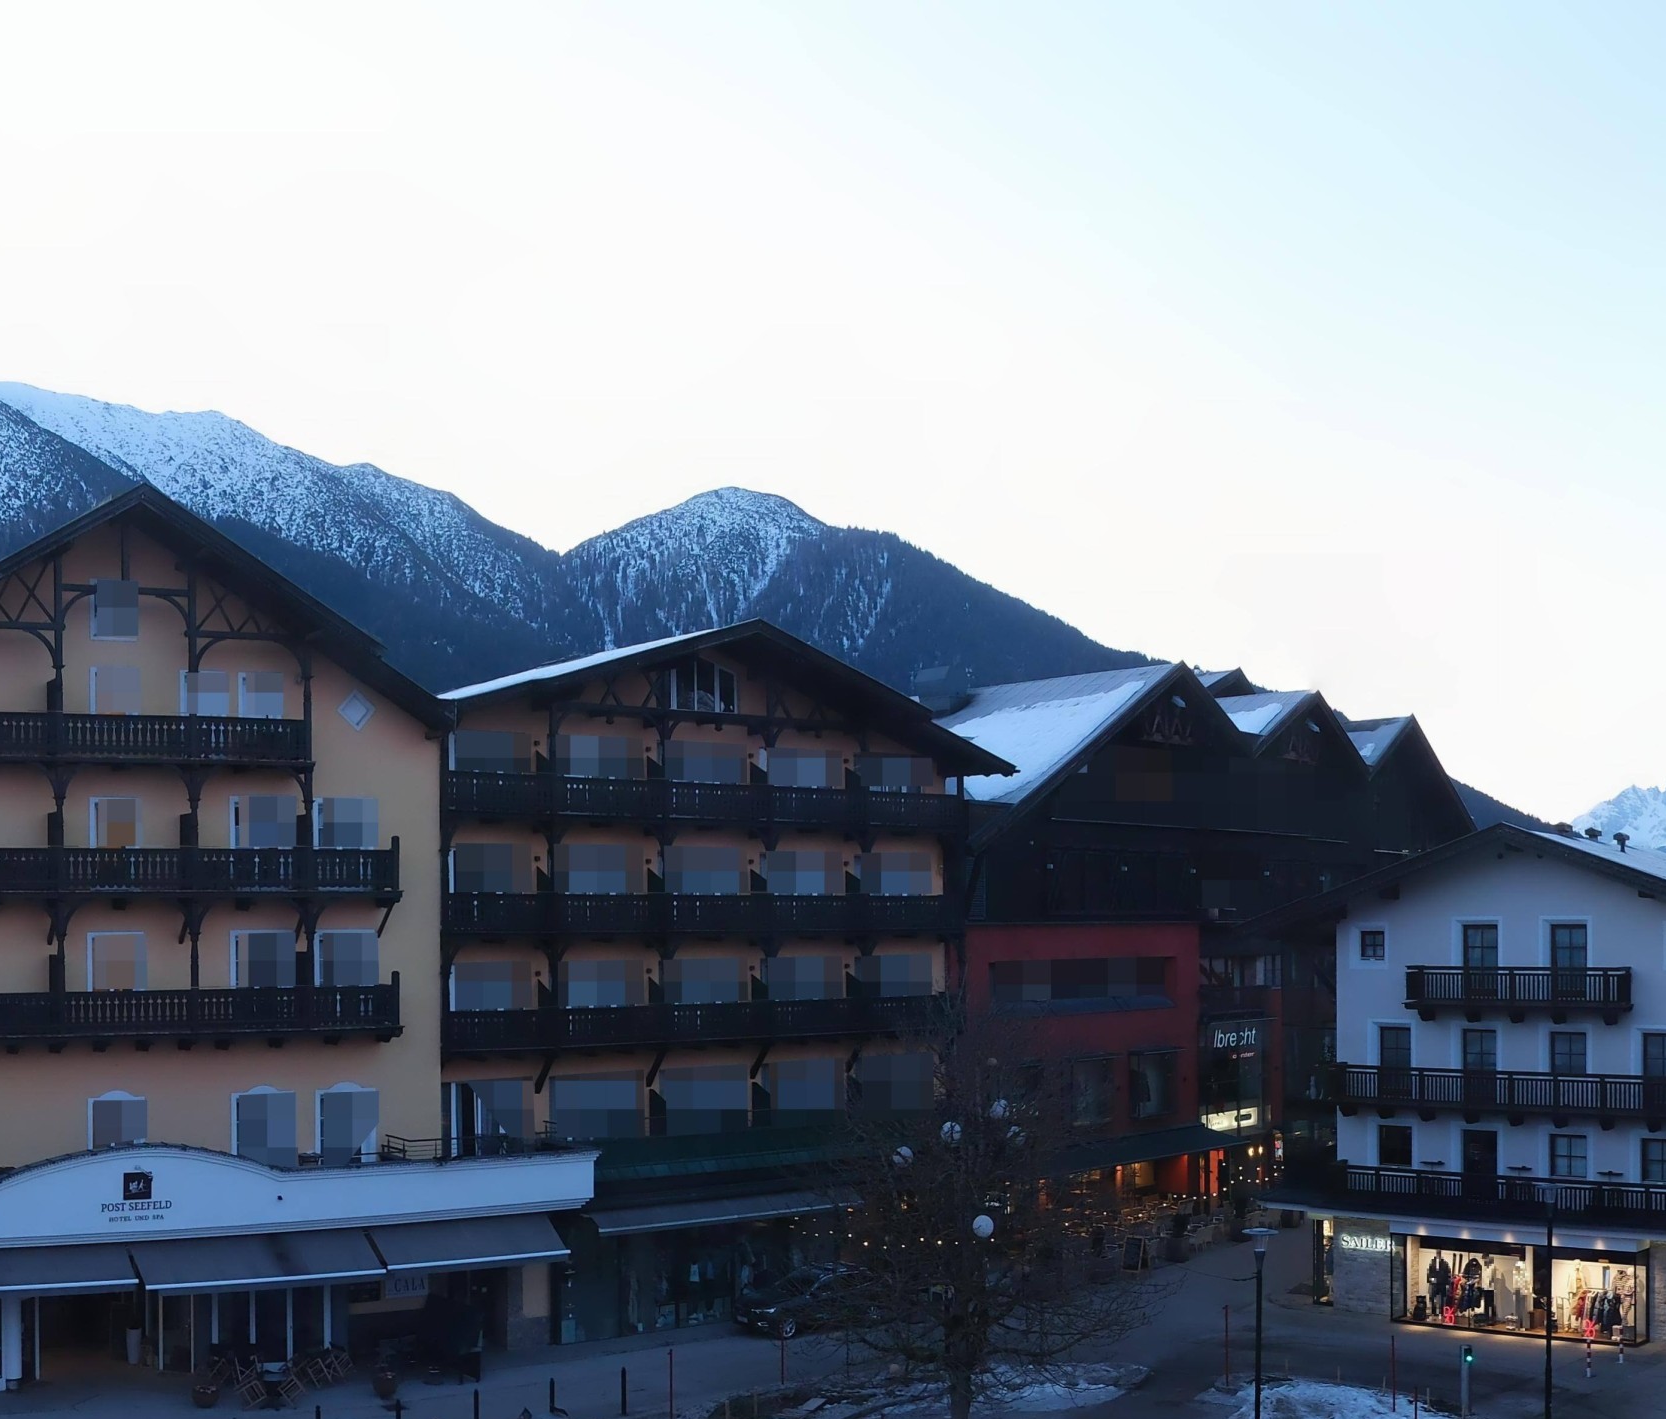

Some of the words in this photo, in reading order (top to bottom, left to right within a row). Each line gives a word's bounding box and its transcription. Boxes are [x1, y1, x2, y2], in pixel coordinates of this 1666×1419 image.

[100, 1202, 126, 1213] POST
[128, 1200, 173, 1212] SEEFELD
[108, 1215, 132, 1223] HOTEL
[1341, 1234, 1395, 1251] SAILER
